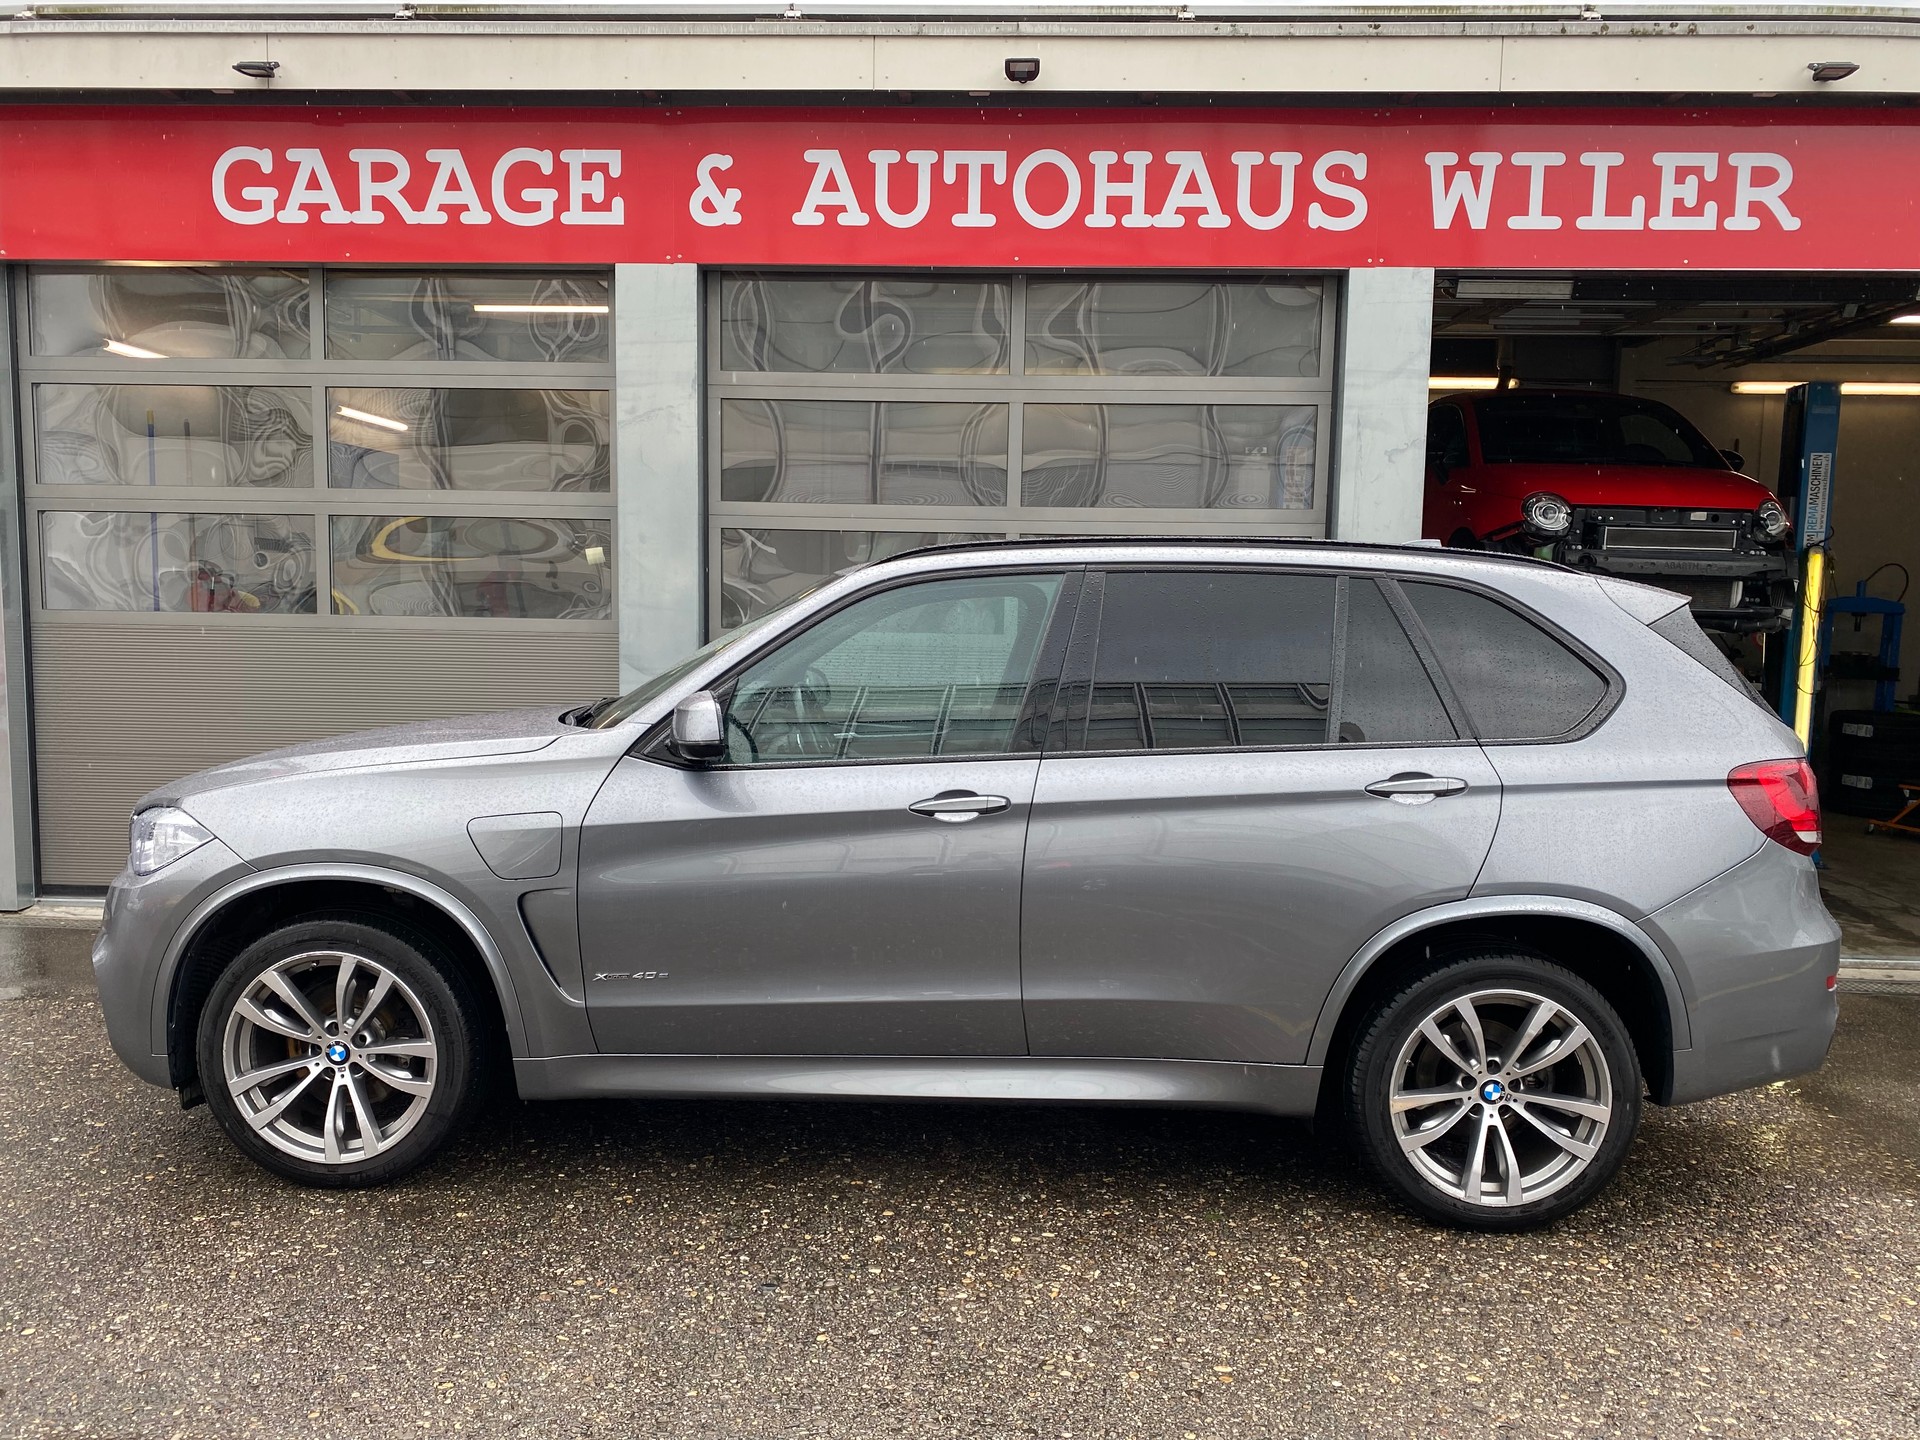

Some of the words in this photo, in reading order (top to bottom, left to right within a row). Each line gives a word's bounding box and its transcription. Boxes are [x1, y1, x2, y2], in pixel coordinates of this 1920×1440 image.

[212, 146, 625, 227] GARAGE
[689, 153, 742, 227] &
[792, 149, 1368, 231] AUTOHAUS
[1425, 152, 1802, 231] WILER
[1806, 454, 1823, 531] REMAMASCHINEN
